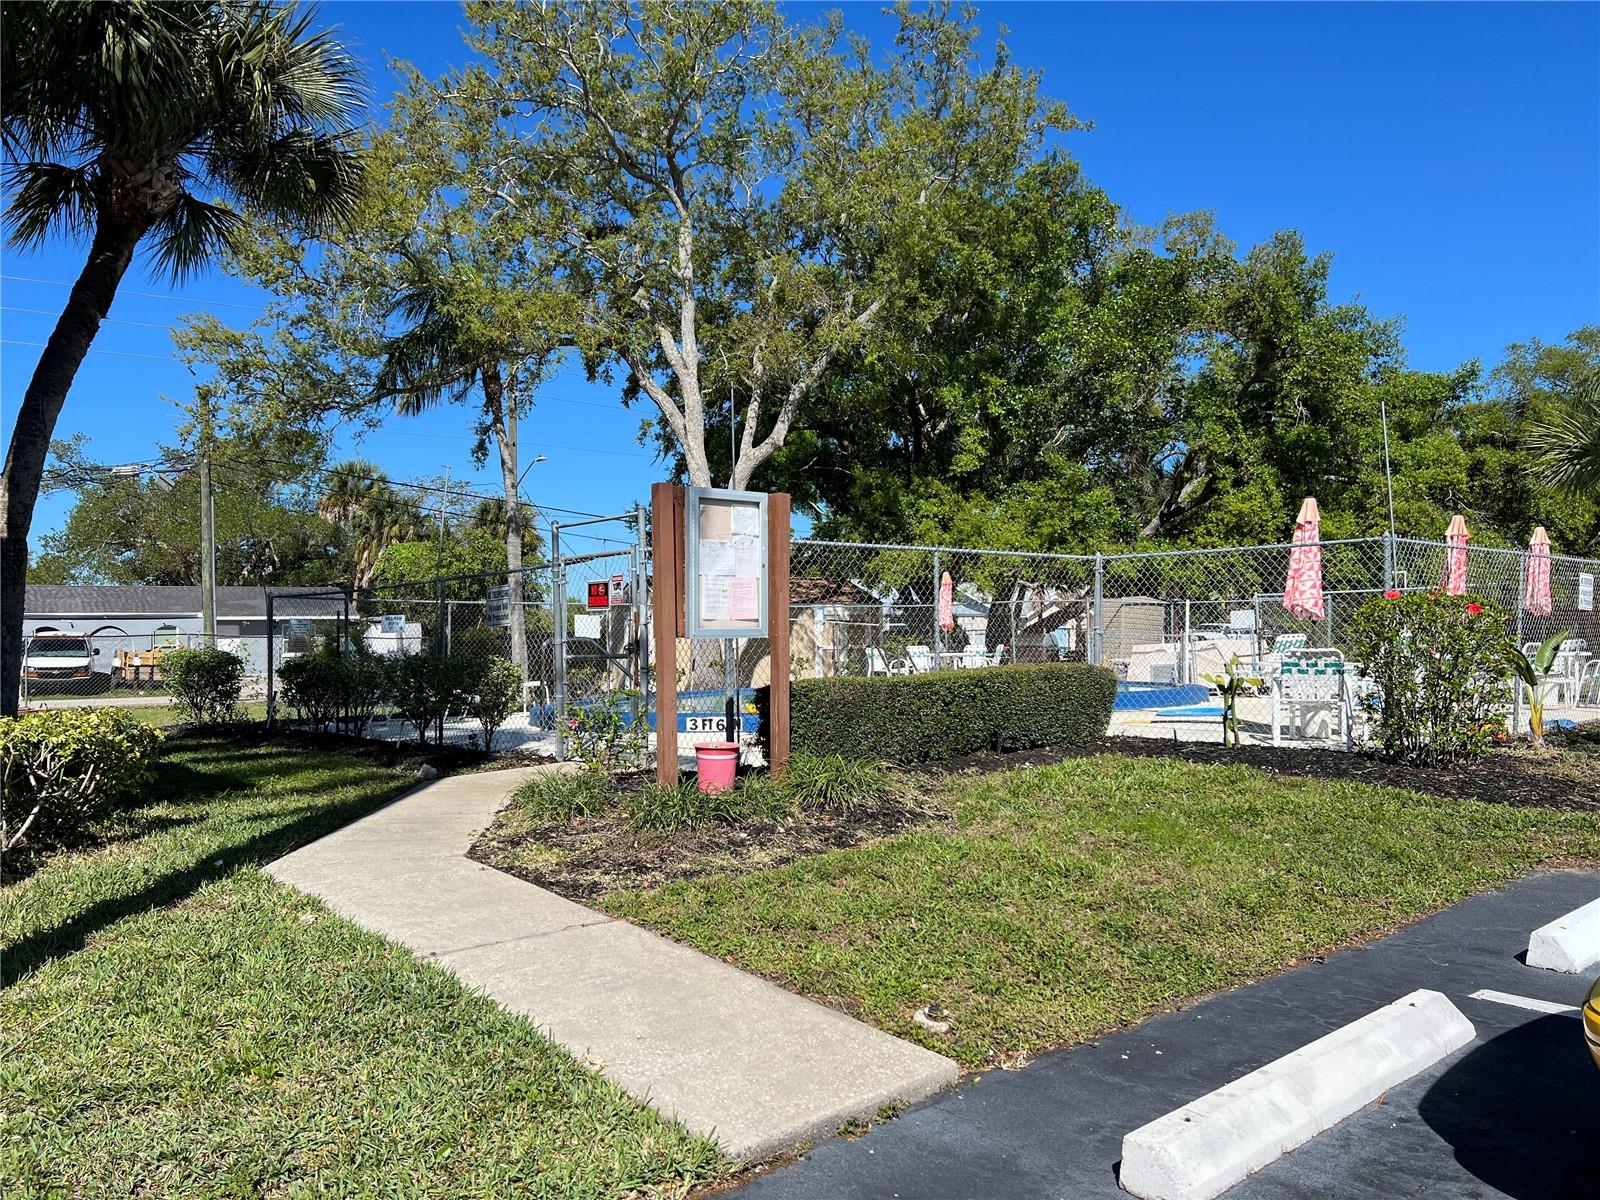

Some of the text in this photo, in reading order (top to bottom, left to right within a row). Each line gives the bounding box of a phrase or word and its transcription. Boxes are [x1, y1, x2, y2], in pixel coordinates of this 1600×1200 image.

[689, 718, 699, 731] 3
[702, 718, 714, 731] FT
[716, 718, 726, 731] 6
